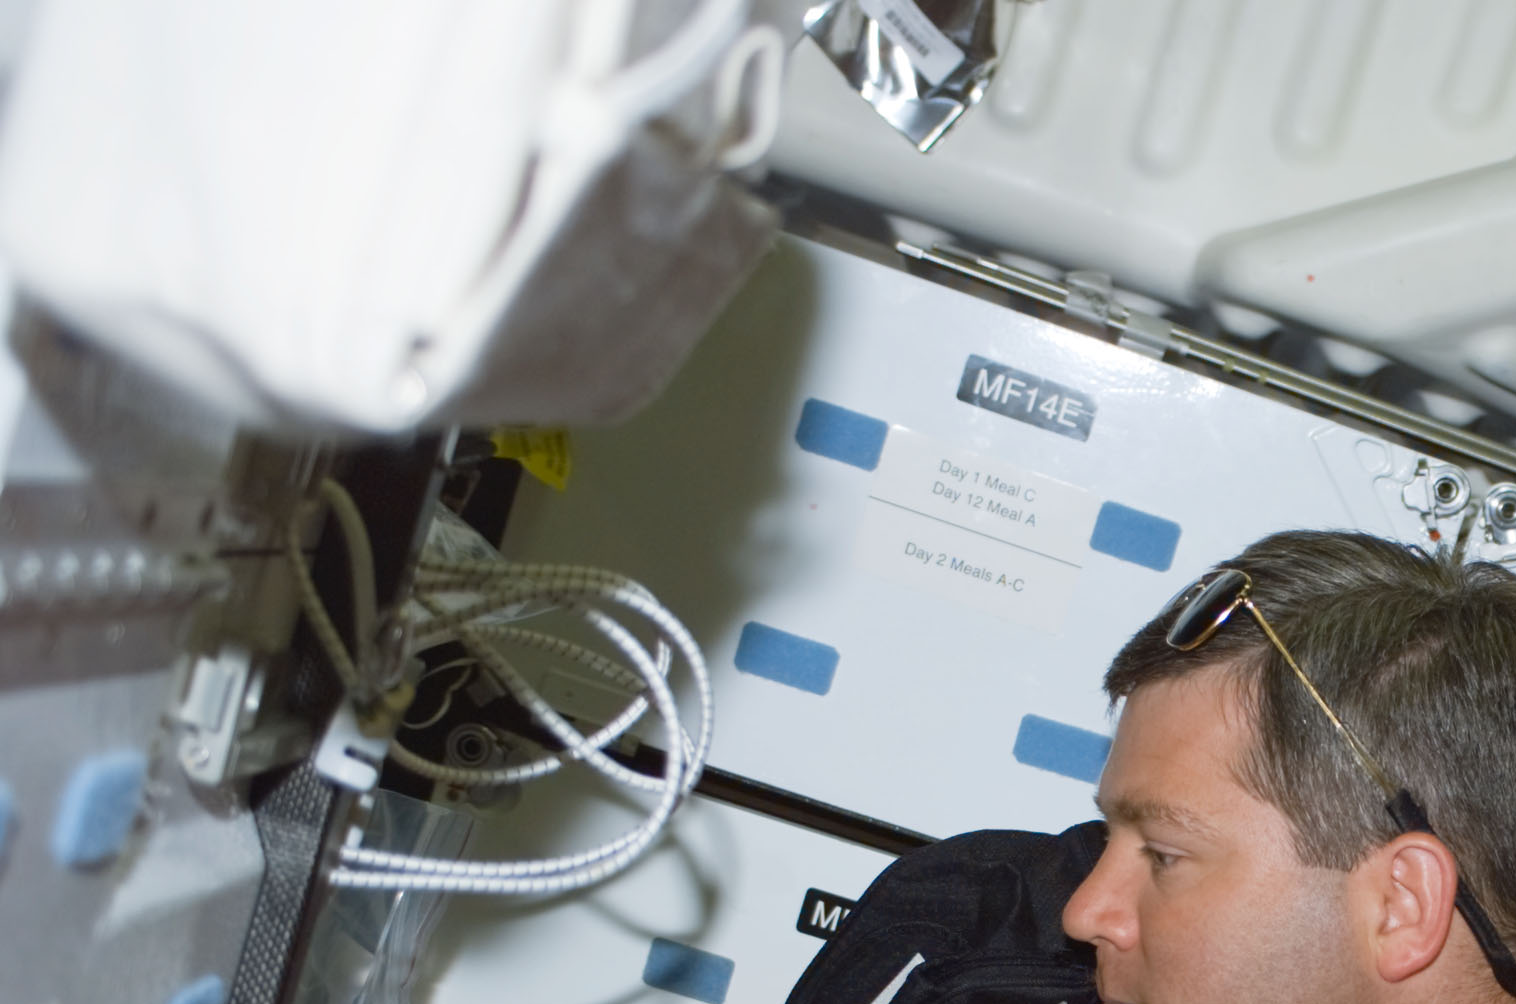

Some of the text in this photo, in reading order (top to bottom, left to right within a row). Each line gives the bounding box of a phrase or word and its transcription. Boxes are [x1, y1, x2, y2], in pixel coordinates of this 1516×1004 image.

[974, 368, 1083, 428] MF14E
[932, 480, 1037, 527] Day 12 Meal A
[939, 459, 1037, 503] Day 1 Meal C
[904, 541, 1025, 592] Day 2 Meals A-C
[811, 900, 851, 932] M
